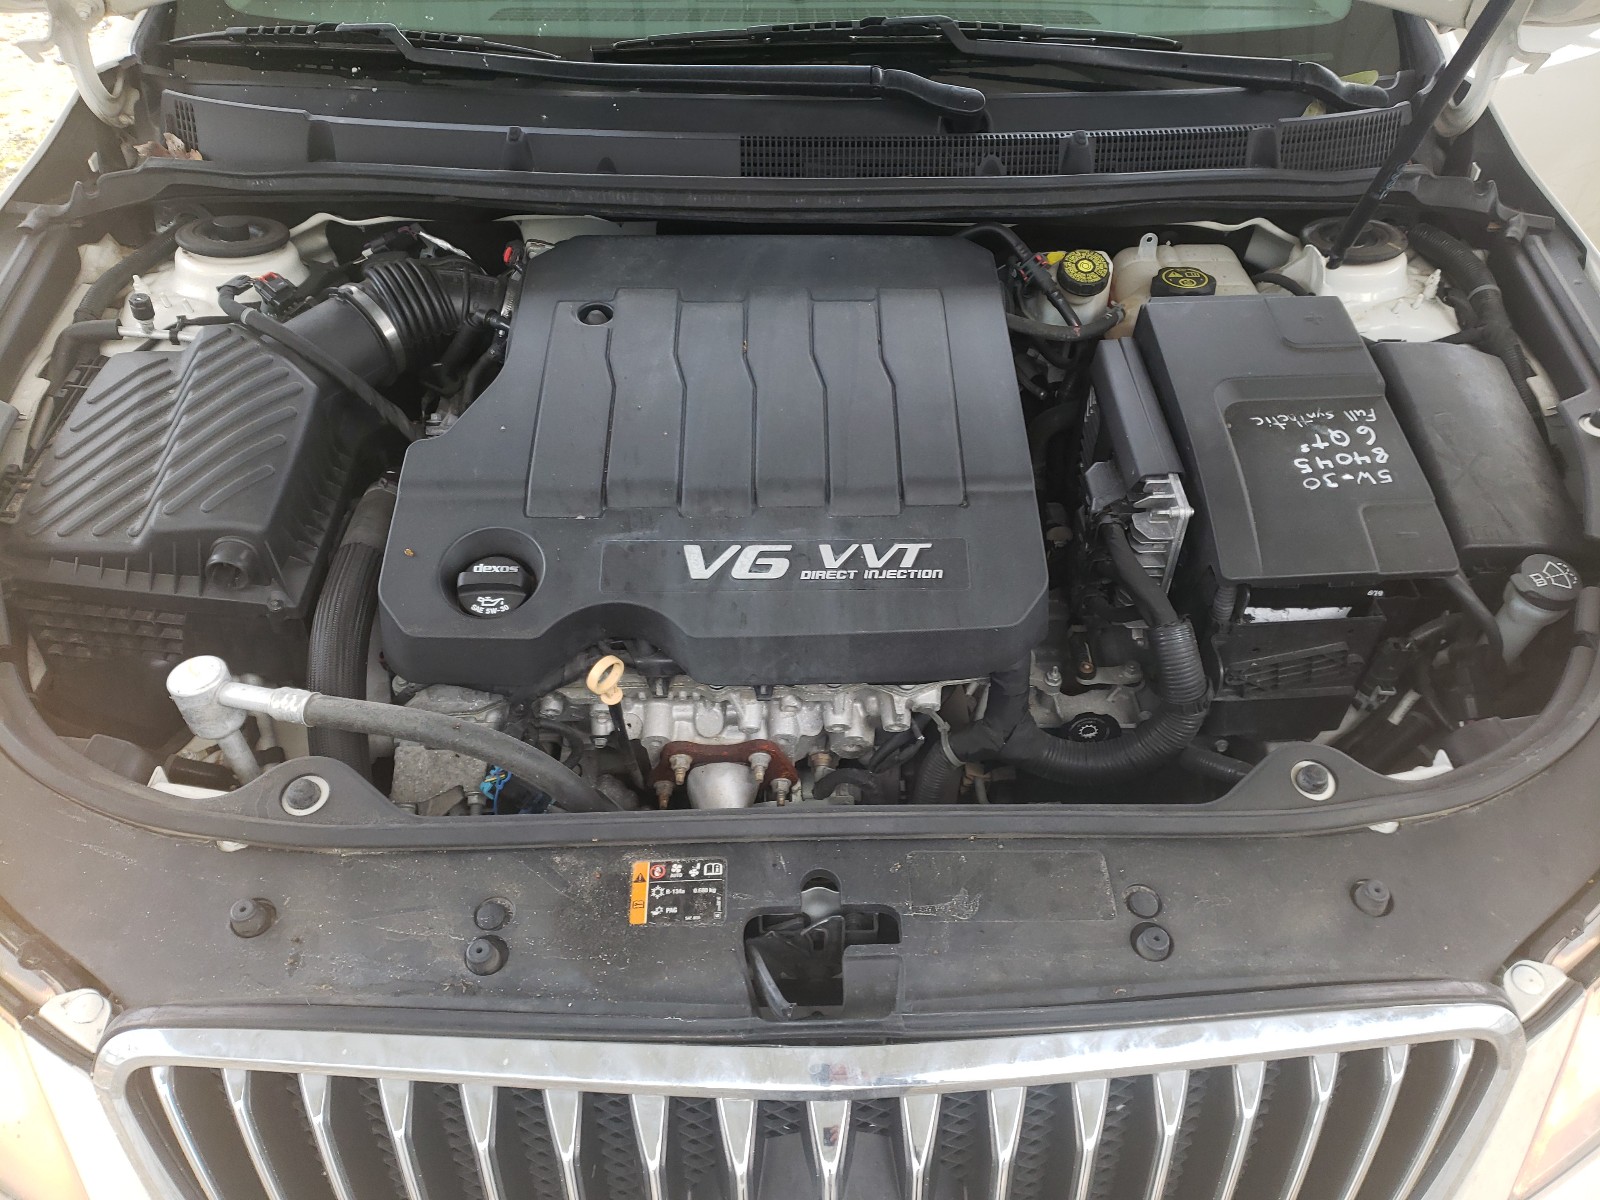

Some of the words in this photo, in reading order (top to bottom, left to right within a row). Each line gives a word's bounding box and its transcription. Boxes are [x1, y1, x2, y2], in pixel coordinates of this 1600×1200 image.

[1344, 408, 1377, 422] Full
[1356, 425, 1377, 446] 6
[1294, 447, 1390, 474] 84045
[1302, 469, 1393, 491] 5W-30
[472, 563, 520, 573] dexos
[683, 544, 793, 580] V6
[818, 543, 933, 569] VVT
[800, 570, 858, 580] DIRECT
[863, 569, 944, 580] INJECTION
[470, 604, 484, 613] SAE
[485, 604, 510, 614] 5W-30
